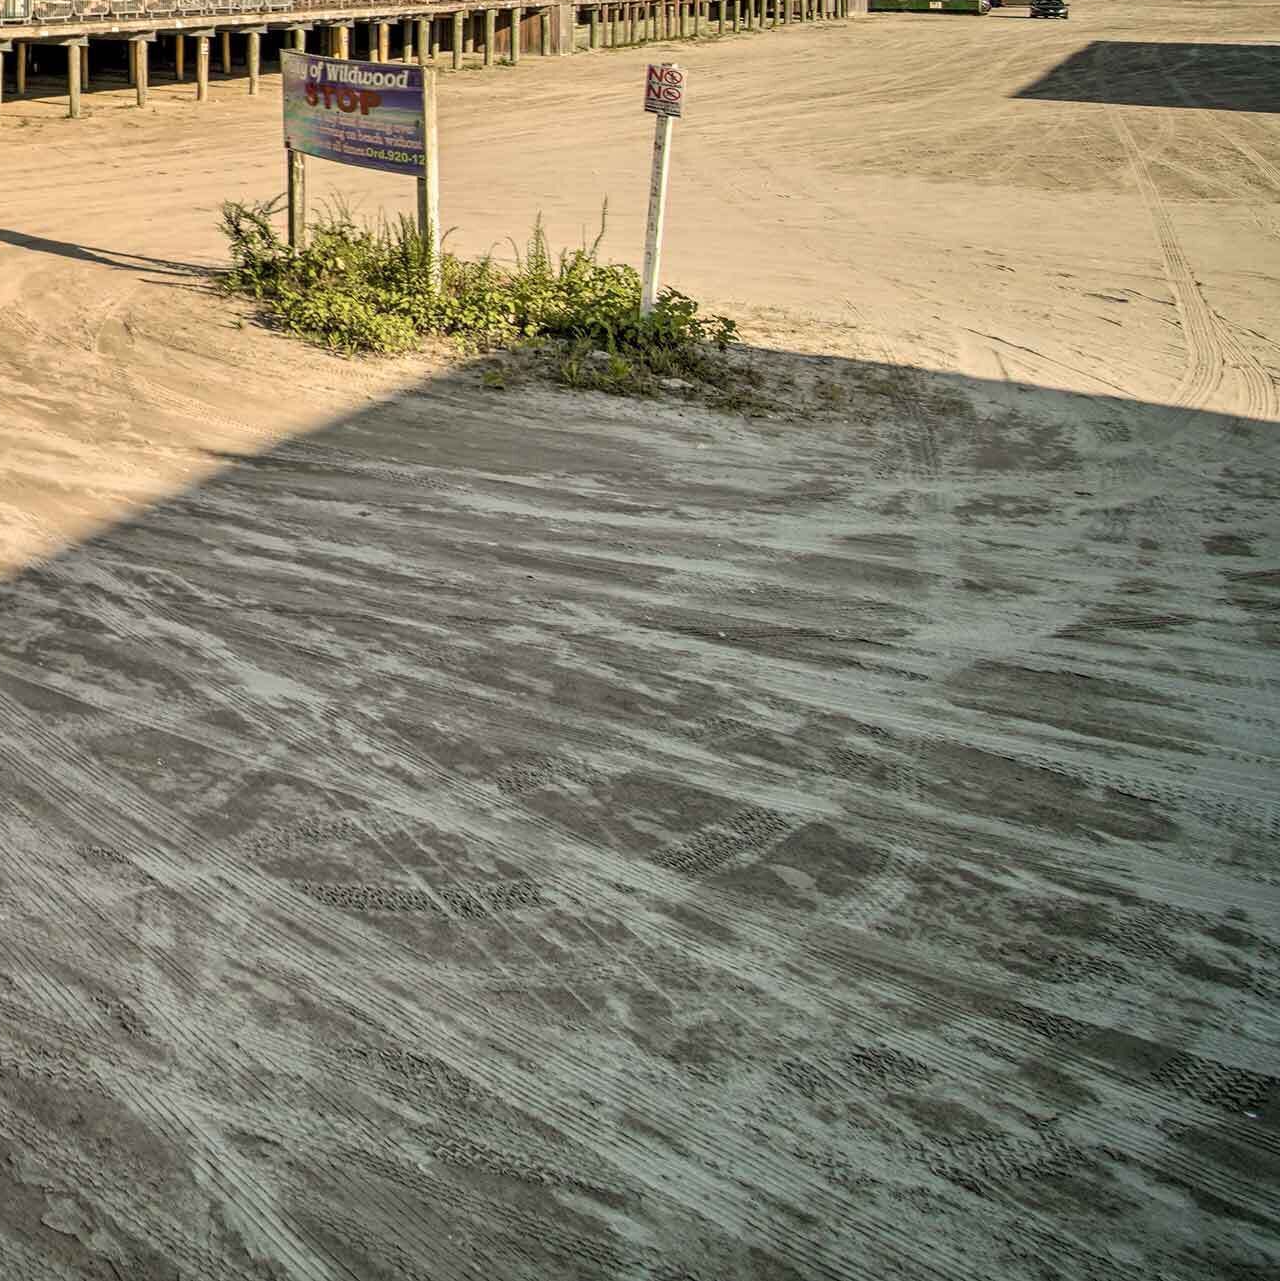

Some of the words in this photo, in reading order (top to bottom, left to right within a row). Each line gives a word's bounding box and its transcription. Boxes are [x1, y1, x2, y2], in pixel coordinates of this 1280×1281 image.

[310, 62, 324, 83] of
[326, 63, 409, 89] Wildwood
[305, 81, 383, 116] STOP
